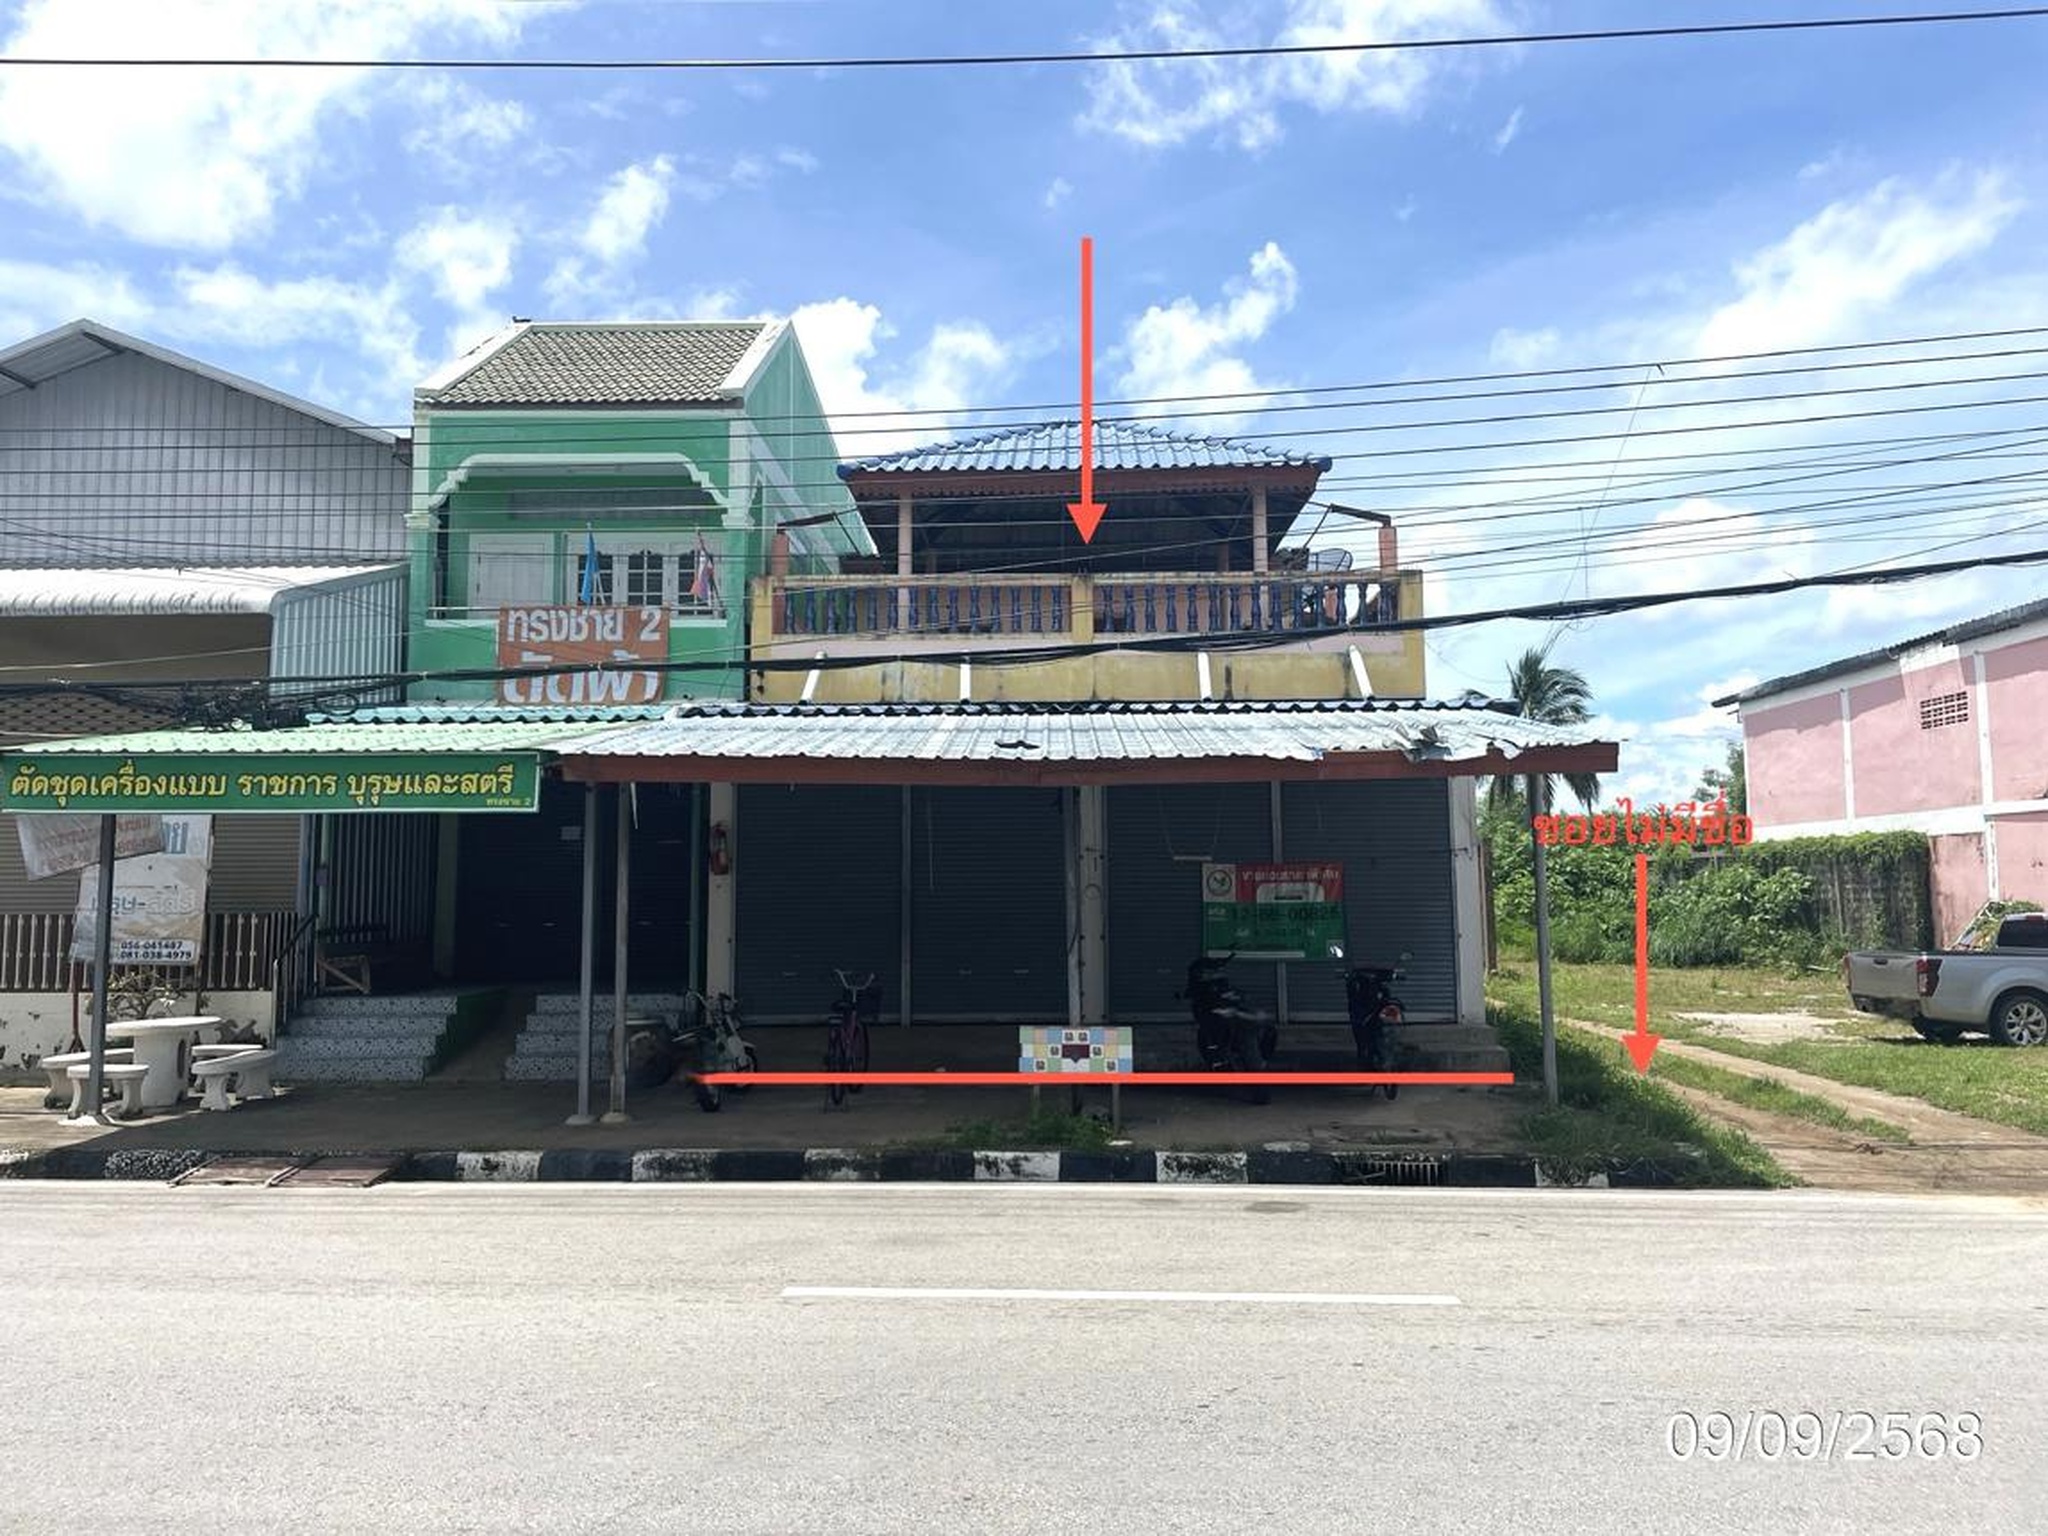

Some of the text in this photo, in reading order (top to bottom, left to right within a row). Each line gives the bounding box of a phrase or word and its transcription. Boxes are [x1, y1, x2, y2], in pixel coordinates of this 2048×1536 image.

[506, 605, 662, 643] ทรงชาย 2
[10, 758, 515, 808] ตัดชุดเครื่องแบบ ราชการ บุรุษและสตรี
